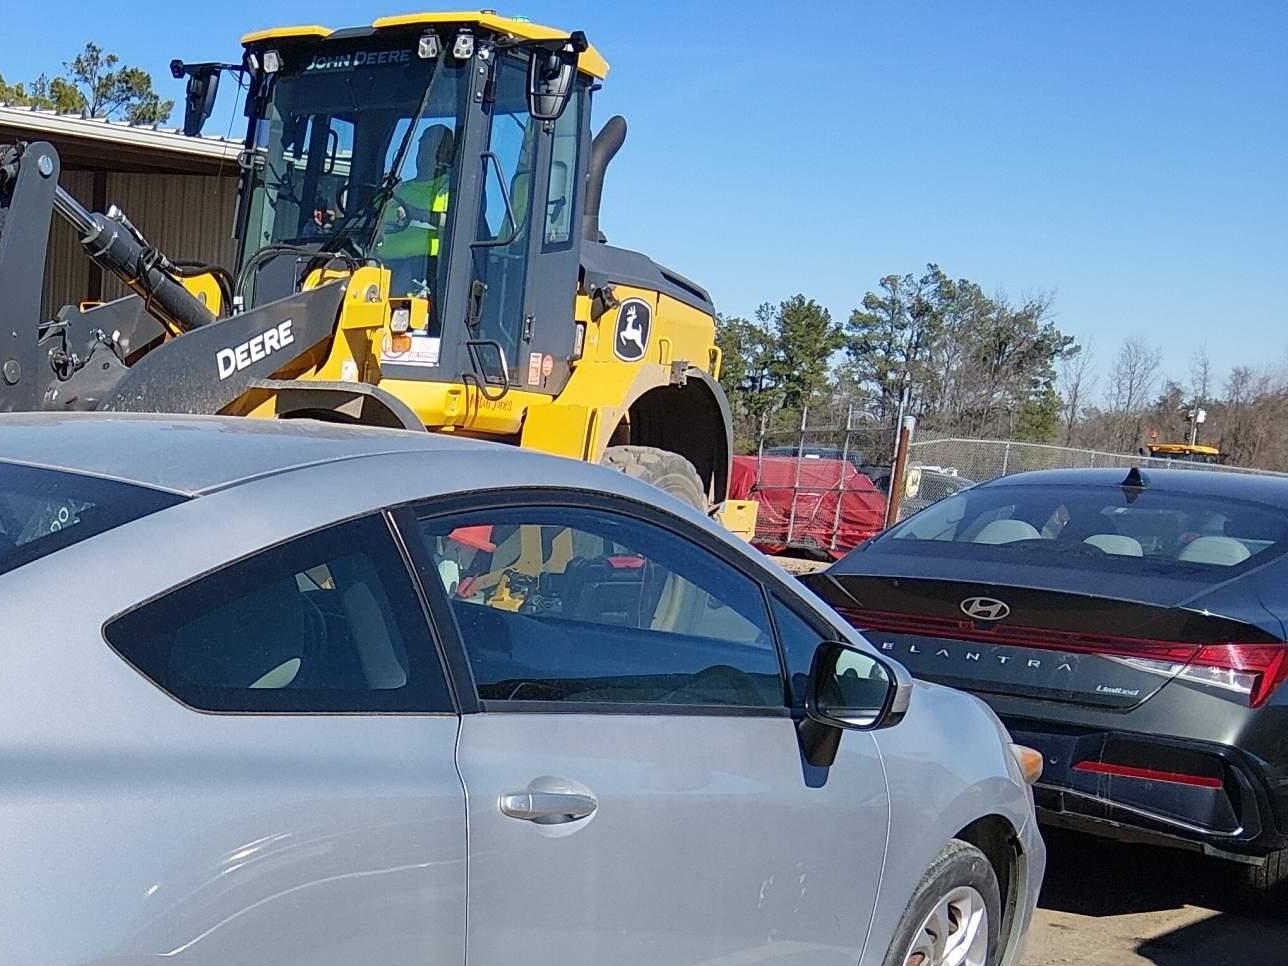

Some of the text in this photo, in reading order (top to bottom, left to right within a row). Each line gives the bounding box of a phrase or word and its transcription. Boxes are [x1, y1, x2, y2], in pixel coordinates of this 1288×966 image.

[306, 49, 411, 71] JOHN DEERE
[216, 319, 294, 381] DEERE
[881, 642, 1073, 672] ELANTRA
[1095, 684, 1140, 697] Limited
